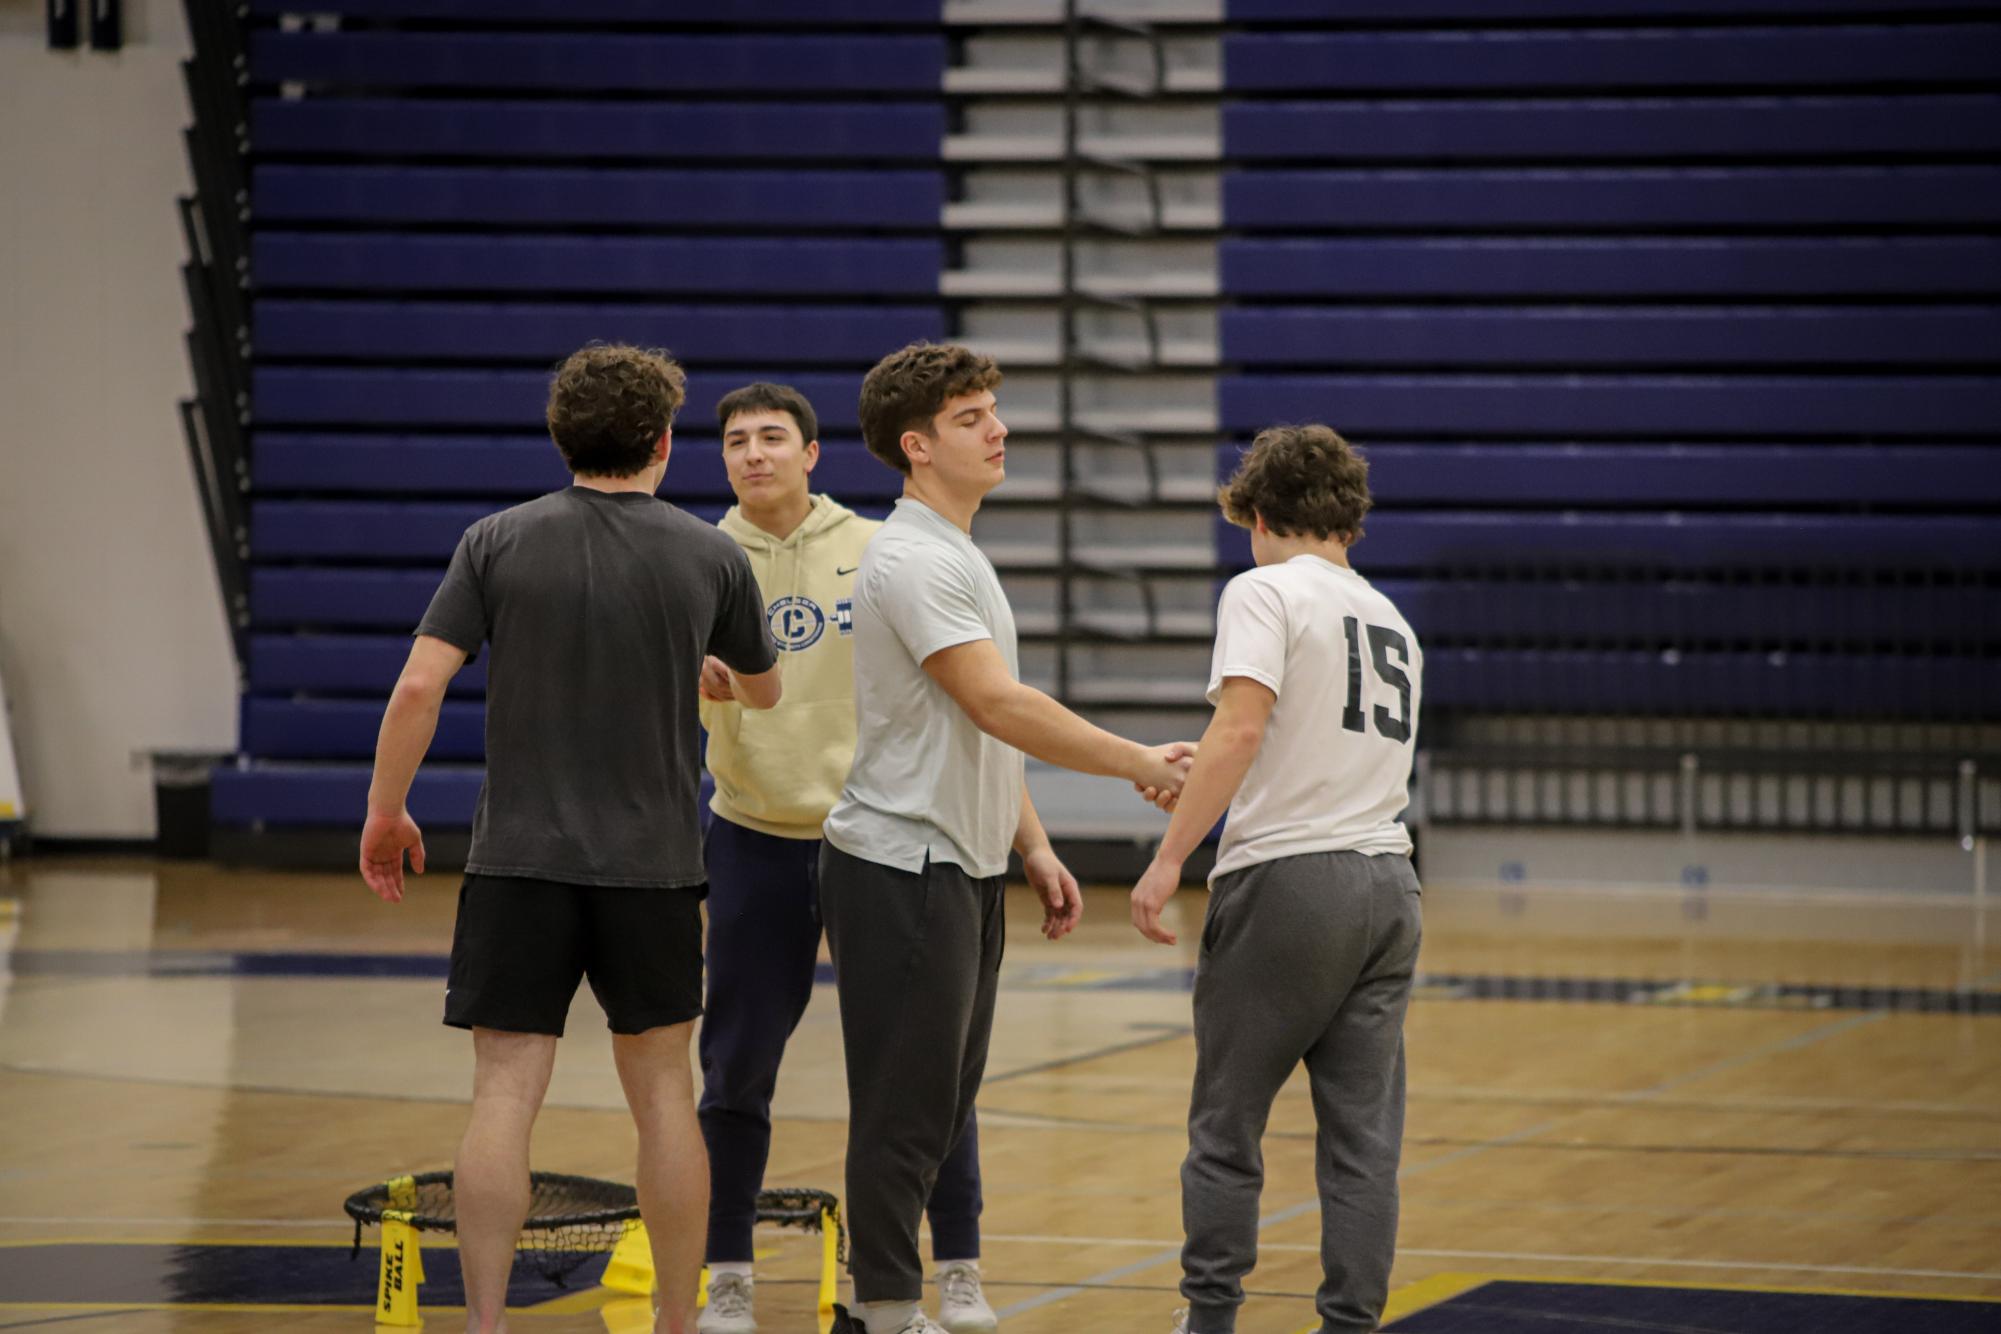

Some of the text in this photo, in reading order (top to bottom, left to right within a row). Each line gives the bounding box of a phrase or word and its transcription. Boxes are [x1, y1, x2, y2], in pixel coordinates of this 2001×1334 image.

[1342, 615, 1411, 745] 15
[383, 1253, 393, 1312] SPIKE
[393, 1240, 404, 1292] BALL
